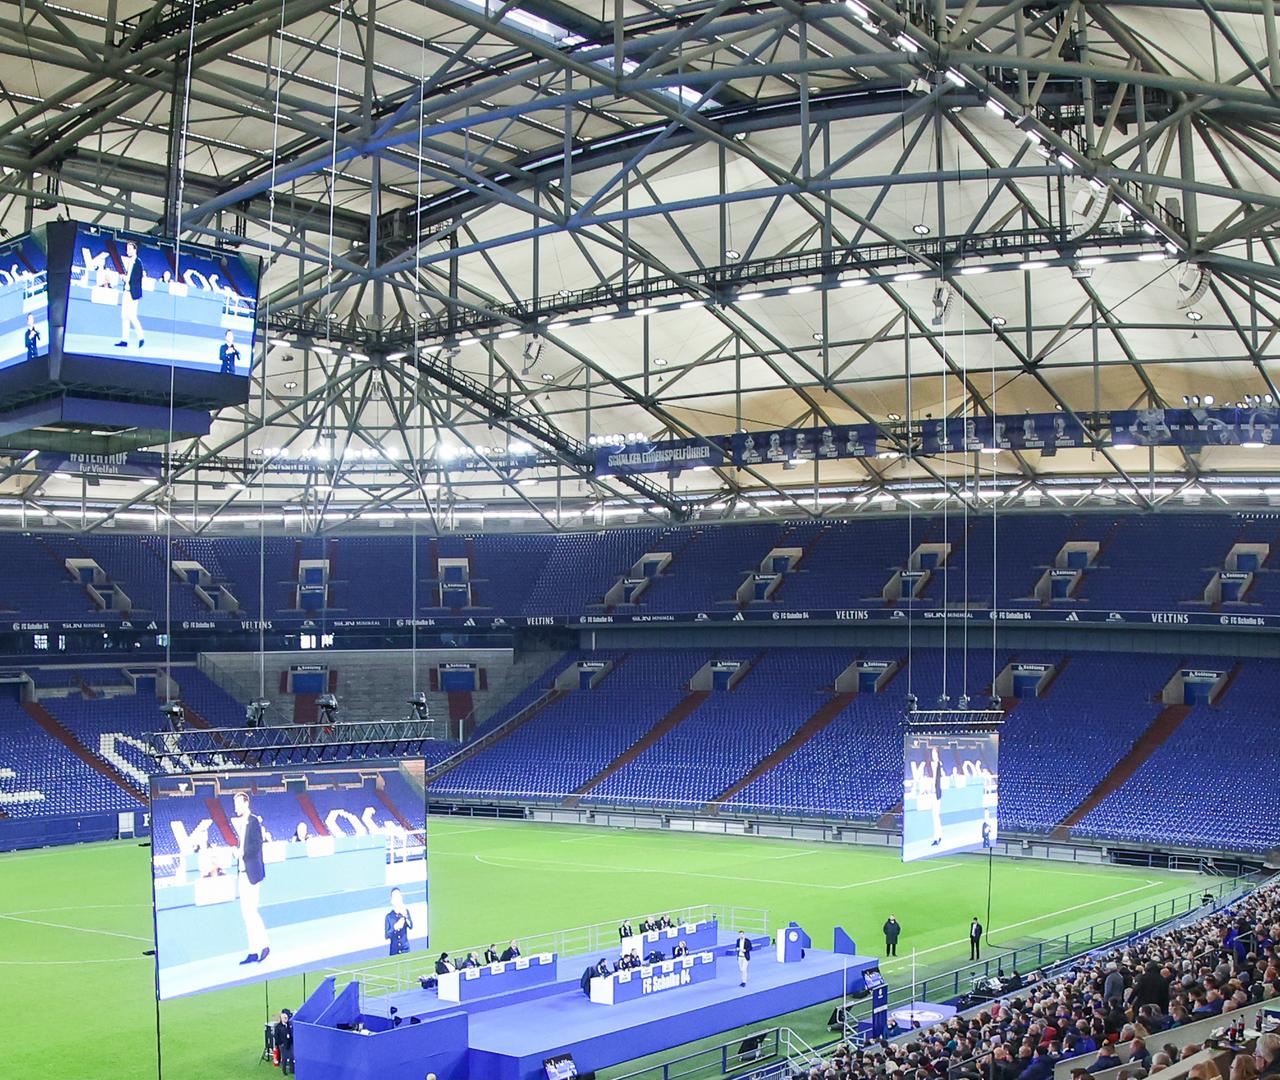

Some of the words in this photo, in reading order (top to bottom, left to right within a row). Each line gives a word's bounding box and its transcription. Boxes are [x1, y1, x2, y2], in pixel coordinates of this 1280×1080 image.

[835, 610, 869, 620] VELTINS
[1151, 613, 1189, 624] VELTINS
[526, 617, 554, 626] VELTINS
